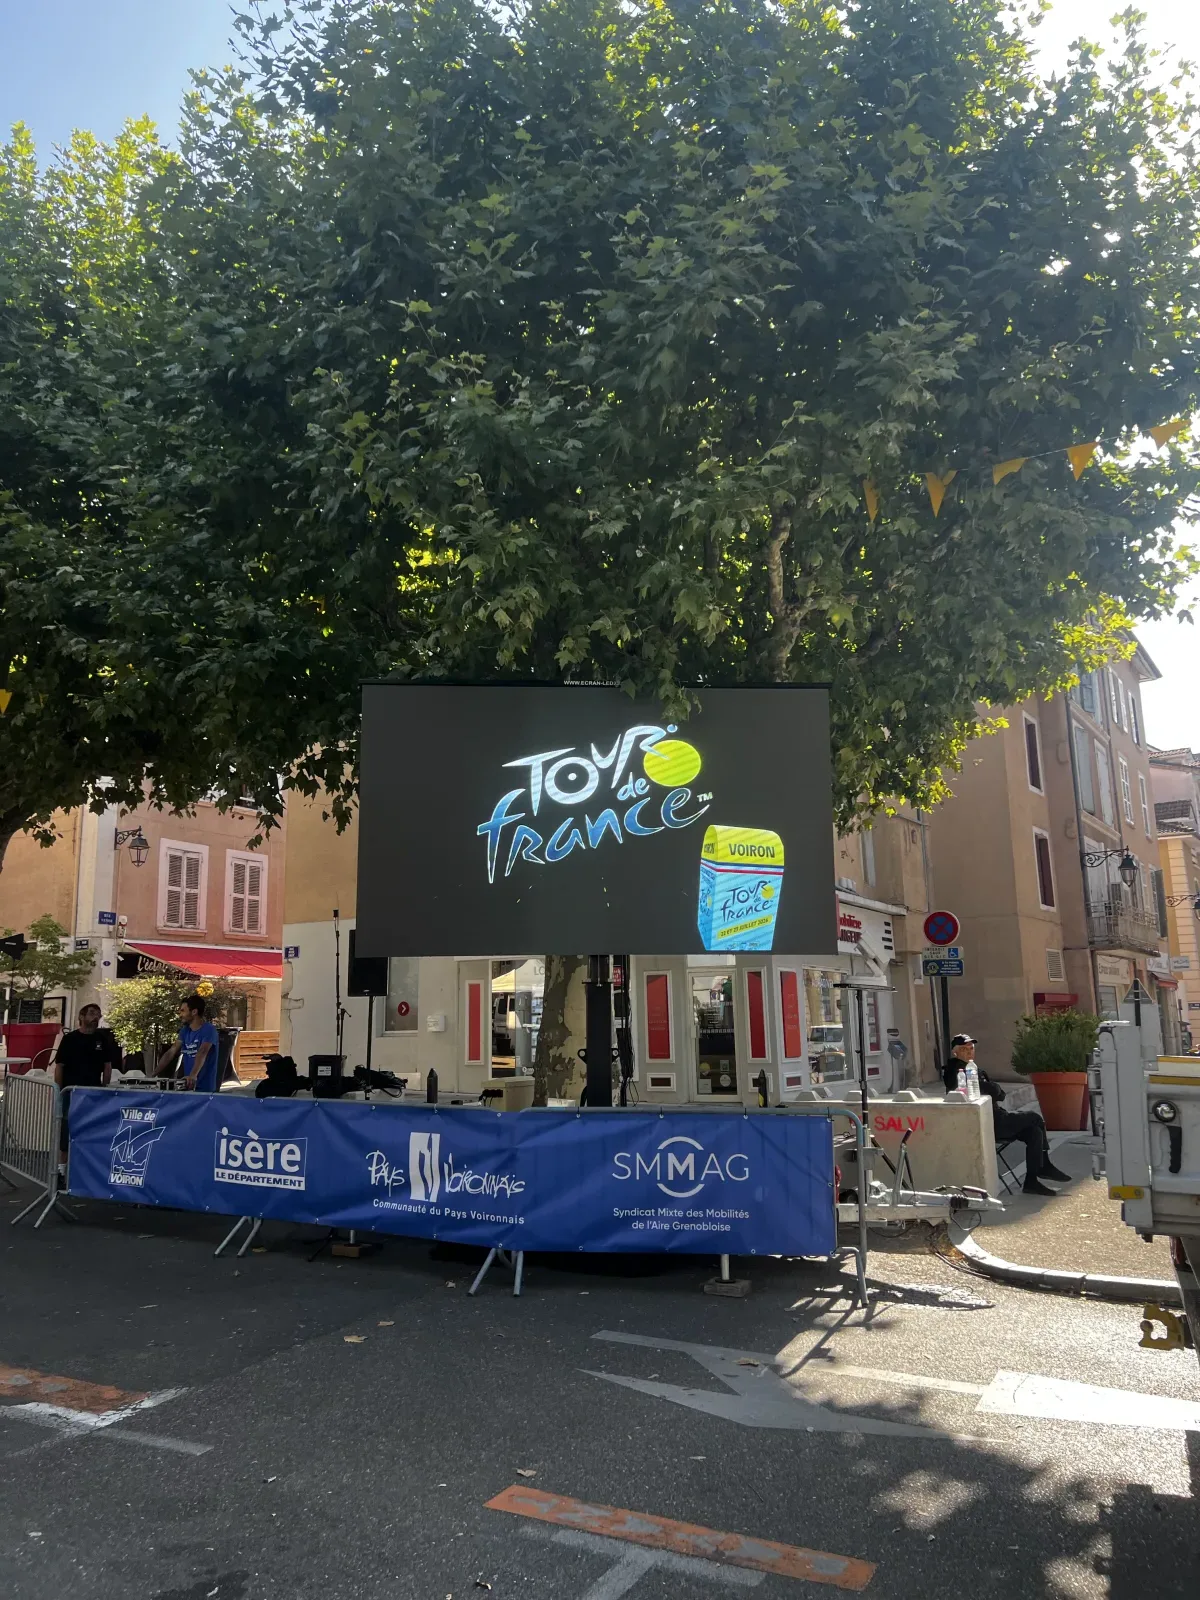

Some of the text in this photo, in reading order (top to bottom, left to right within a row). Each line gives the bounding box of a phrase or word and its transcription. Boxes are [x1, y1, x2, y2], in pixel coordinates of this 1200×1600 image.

[617, 771, 650, 800] de
[728, 843, 776, 859] VOIRON
[739, 920, 757, 931] JUILLET
[121, 1109, 156, 1121] Ville de
[874, 1115, 925, 1132] SALVI
[219, 1126, 301, 1173] isère
[612, 1152, 749, 1181] SMMAG
[110, 1173, 143, 1187] VOIRON
[216, 1171, 304, 1188] LE DÉPARTEMENT
[373, 1198, 525, 1225] Communauté du Pays Voironnais
[613, 1207, 750, 1219] Syndicat Mixte des Mobilités
[631, 1220, 731, 1232] de l'Aire Grenobloise
